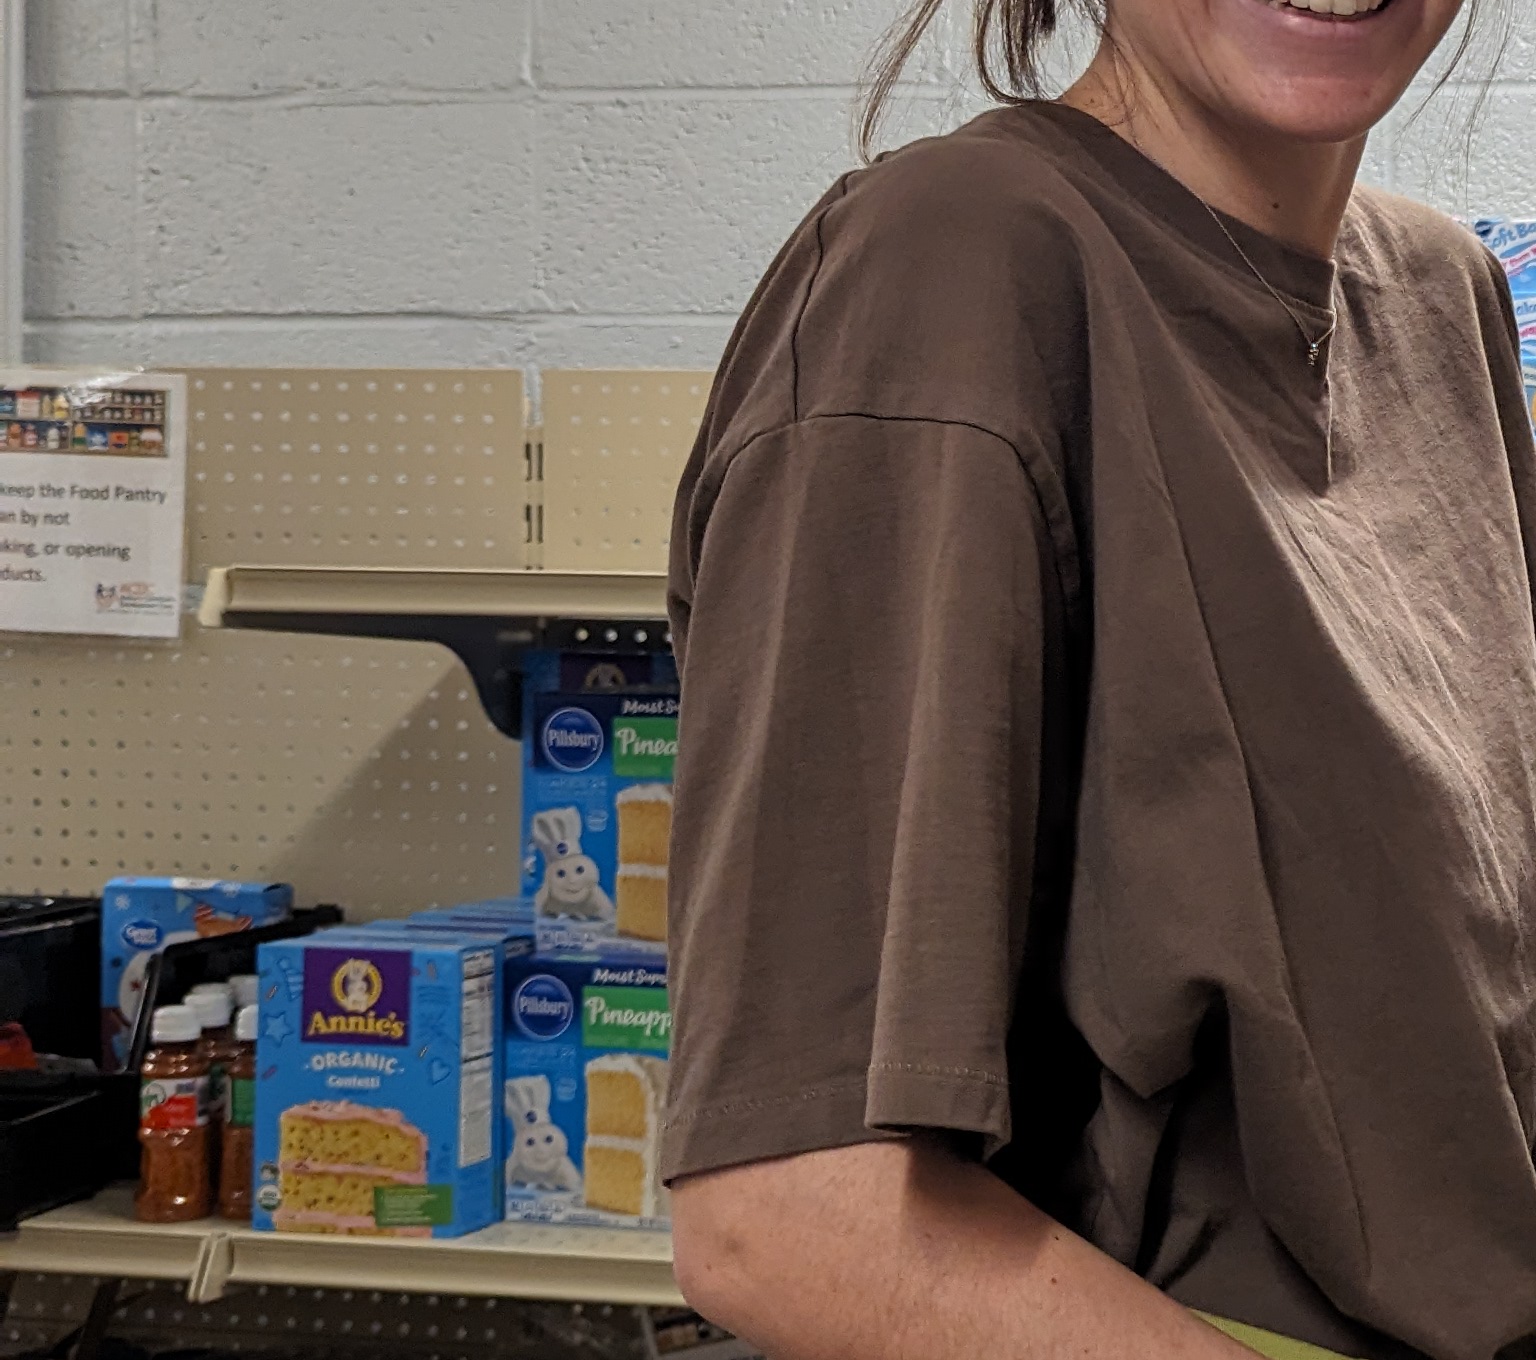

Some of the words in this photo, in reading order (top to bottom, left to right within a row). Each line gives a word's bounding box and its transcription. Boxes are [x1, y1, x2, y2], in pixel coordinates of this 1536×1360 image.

[39, 483, 65, 499] the
[70, 486, 109, 501] Food
[114, 487, 167, 505] Pantry
[20, 509, 38, 527] by
[44, 513, 70, 525] not
[44, 544, 61, 555] or
[65, 543, 131, 562] opening
[622, 700, 664, 714] Moist
[548, 727, 600, 750] Pillsbury
[593, 968, 635, 985] Moist
[518, 996, 569, 1020] Pillsbury
[307, 1011, 405, 1039] Annie's
[311, 1051, 398, 1074] ORGANIC
[326, 1075, 380, 1088] Confetti
